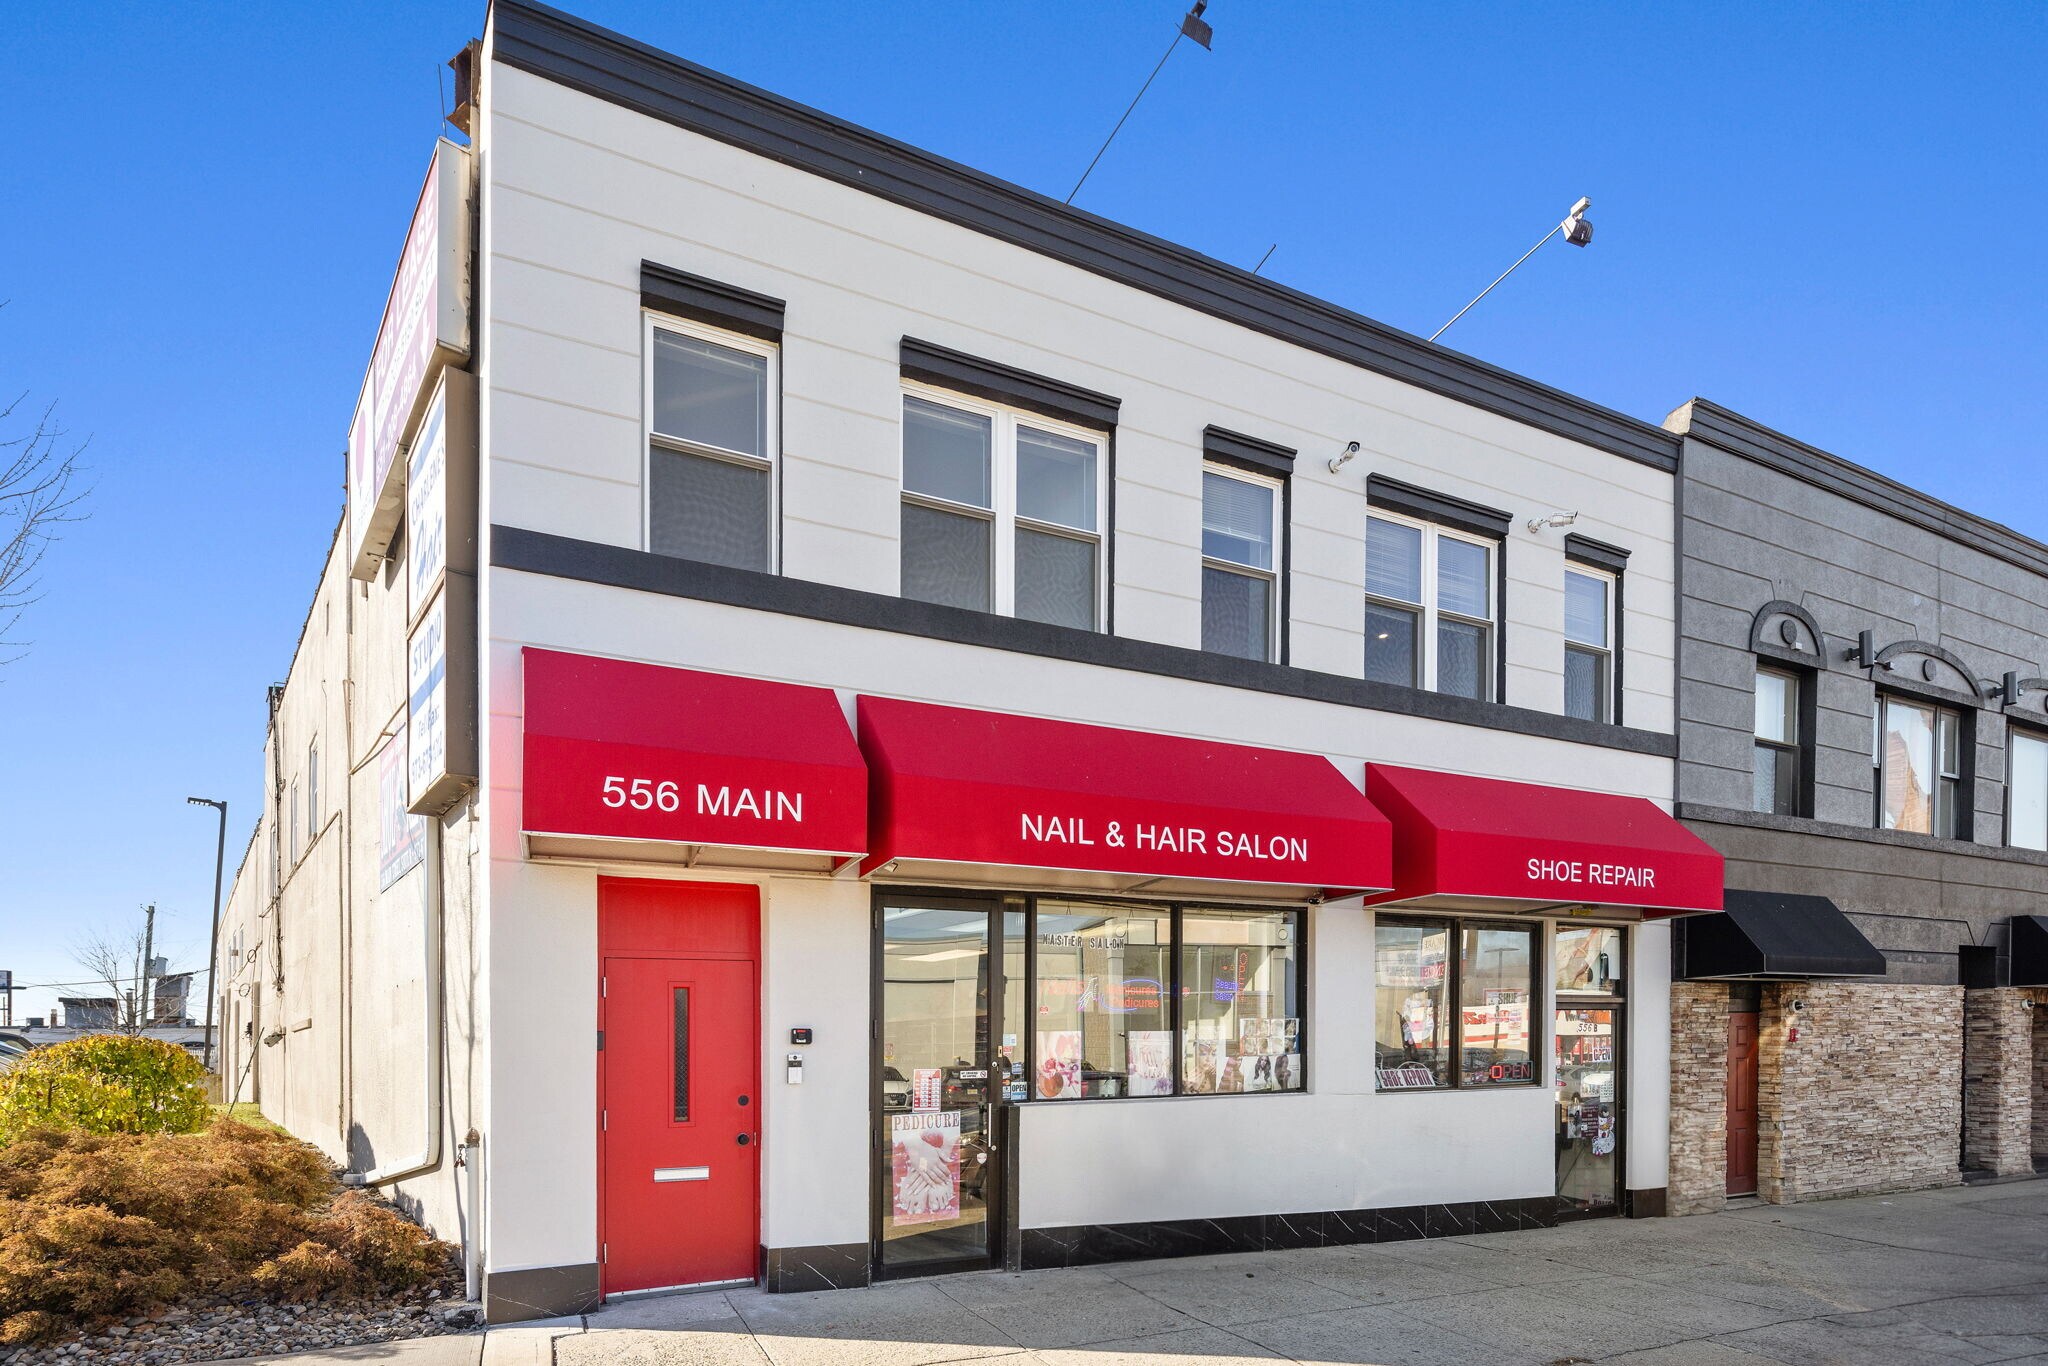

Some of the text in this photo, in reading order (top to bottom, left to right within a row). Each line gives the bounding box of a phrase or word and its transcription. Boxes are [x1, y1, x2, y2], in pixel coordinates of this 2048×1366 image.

[375, 183, 434, 398] FOR LEASE
[413, 611, 442, 677] STUDIO
[602, 776, 803, 822] 556 MAIN
[1021, 813, 1308, 862] NAIL & HAIR SALON
[1527, 858, 1655, 888] SHOE REPAIR
[1042, 933, 1125, 949] MASTER SALON
[1577, 1023, 1592, 1032] 556
[1380, 1069, 1433, 1087] SHOE REPAIR
[1491, 1063, 1530, 1079] OPEN
[1012, 1084, 1027, 1093] OPEN
[893, 1112, 961, 1131] PEDICURE
